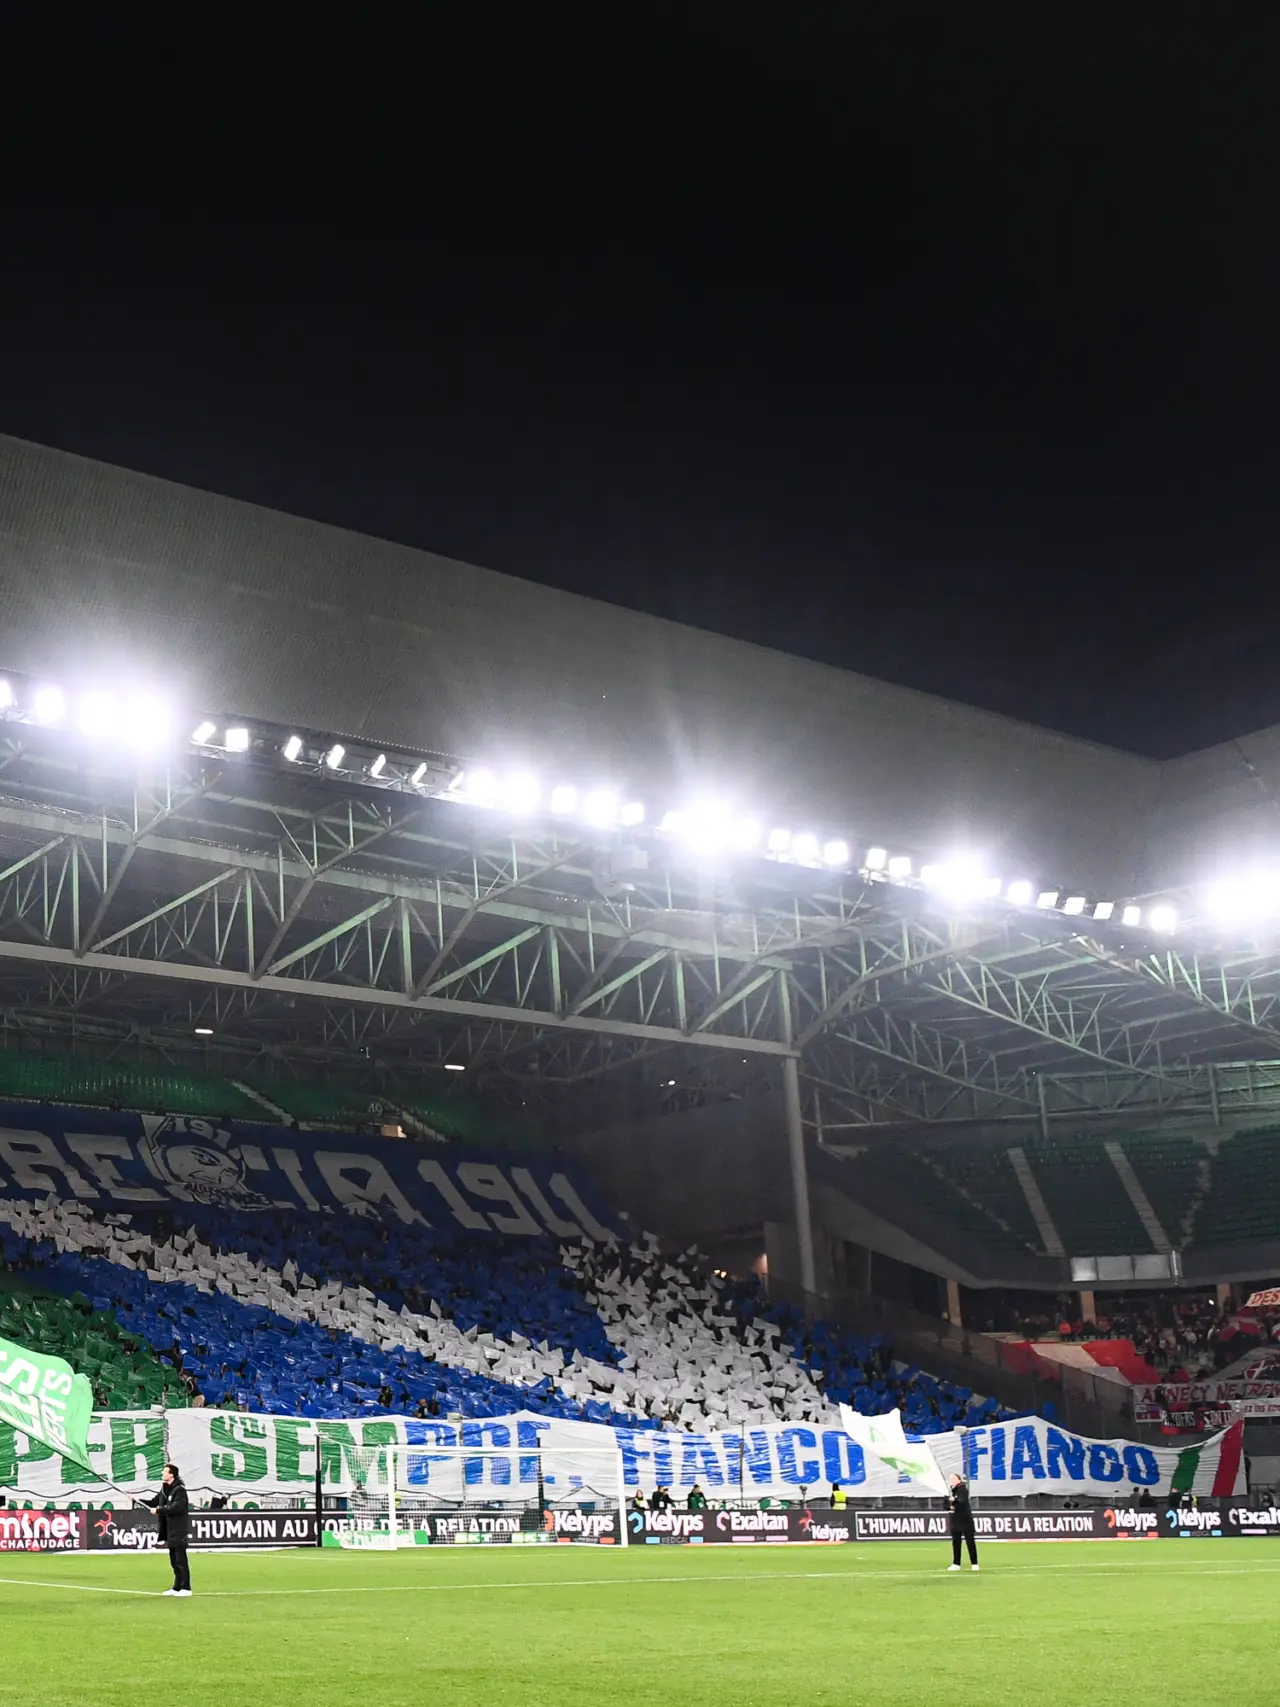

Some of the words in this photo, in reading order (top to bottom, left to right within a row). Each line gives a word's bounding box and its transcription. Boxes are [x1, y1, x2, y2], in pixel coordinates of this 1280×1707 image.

[1141, 1383, 1211, 1404] ANECY
[960, 1424, 1161, 1486] FIANCO
[188, 1519, 277, 1539] 'HUMAIN
[282, 1519, 309, 1538] AU
[314, 1518, 376, 1534] OEUR
[553, 1509, 615, 1537] Kelyps
[644, 1510, 704, 1536] Kelyps
[730, 1510, 789, 1531] Exaltan
[857, 1517, 925, 1534] L'HUMAIN
[928, 1517, 947, 1534] AU
[994, 1517, 1012, 1533] DE
[1014, 1517, 1031, 1532] LA
[1033, 1516, 1094, 1532] RELATION
[1114, 1508, 1158, 1531] Kelyps
[1177, 1508, 1222, 1531] Kelyps
[811, 1524, 849, 1541] Kelyps
